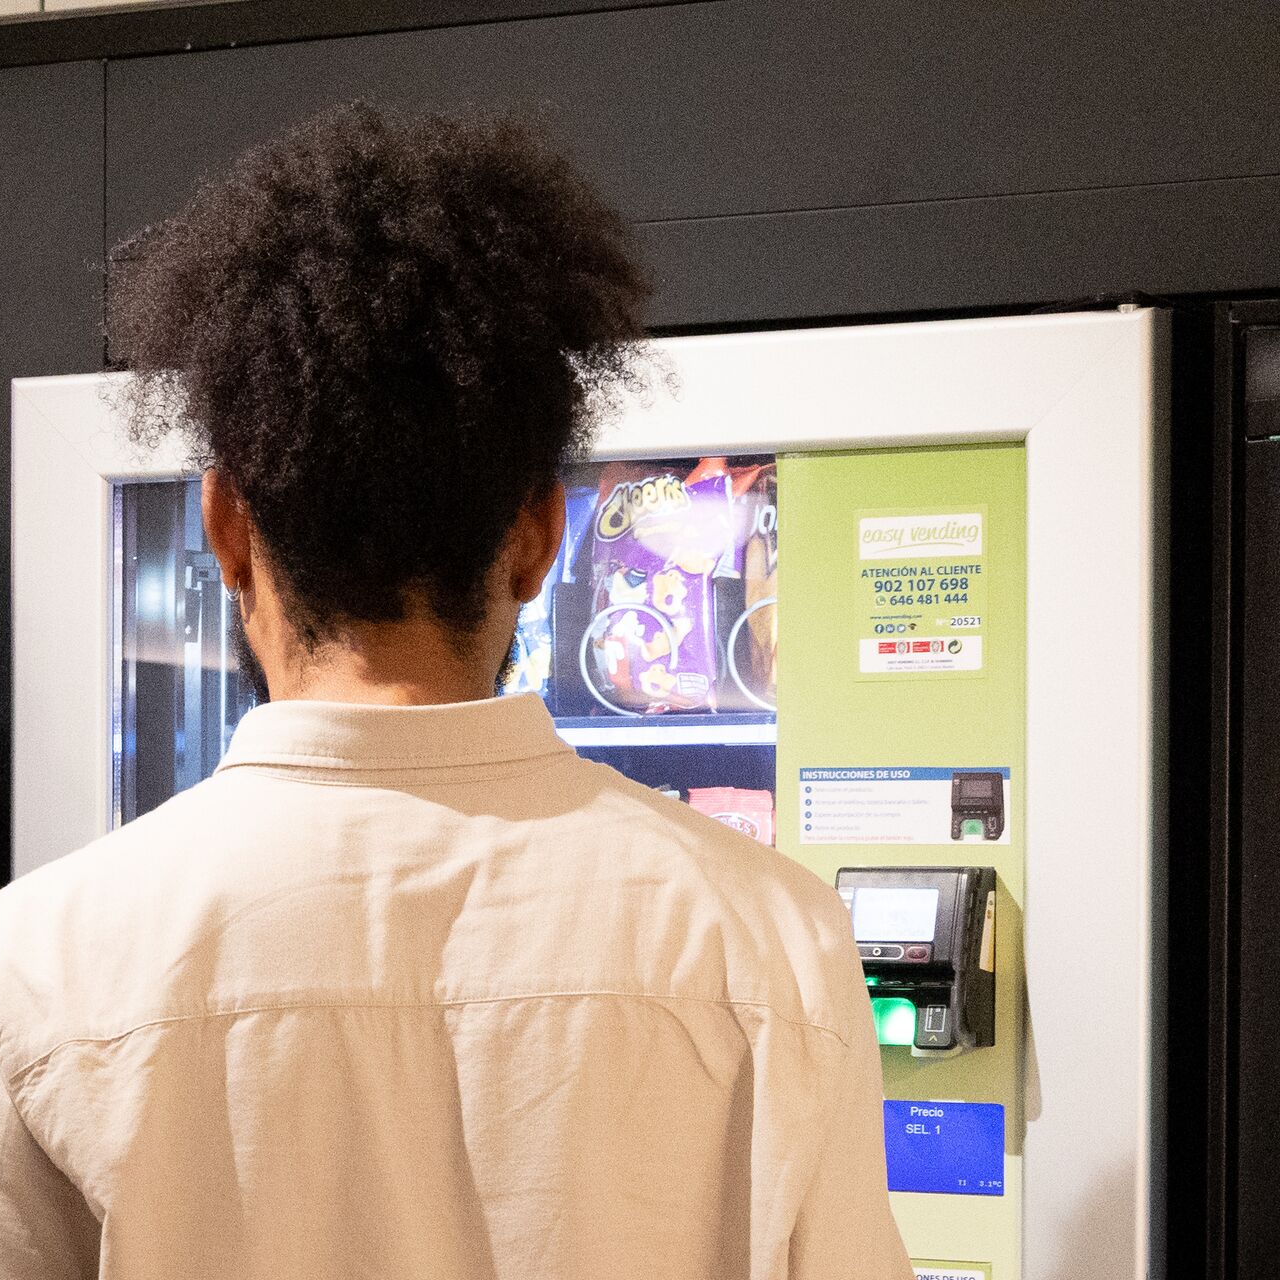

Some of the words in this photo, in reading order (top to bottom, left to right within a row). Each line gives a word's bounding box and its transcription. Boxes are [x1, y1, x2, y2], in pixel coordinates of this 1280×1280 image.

[862, 527, 904, 545] easy
[911, 521, 979, 543] vending
[861, 565, 917, 578] ATENCIÓN
[920, 566, 934, 576] AL
[937, 564, 982, 576] CLIENTE
[874, 579, 903, 593] 902
[908, 578, 935, 592] 107
[940, 577, 969, 591] 698
[890, 595, 913, 606] 646
[917, 594, 939, 604] 481
[944, 593, 968, 604] 444
[950, 617, 981, 626] 20521
[802, 770, 875, 780] INSTRUCCIONES
[876, 770, 889, 779] DE
[890, 770, 910, 779] USO
[910, 1106, 944, 1117] Precio
[905, 1123, 931, 1135] SEL.
[934, 1125, 941, 1135] 1
